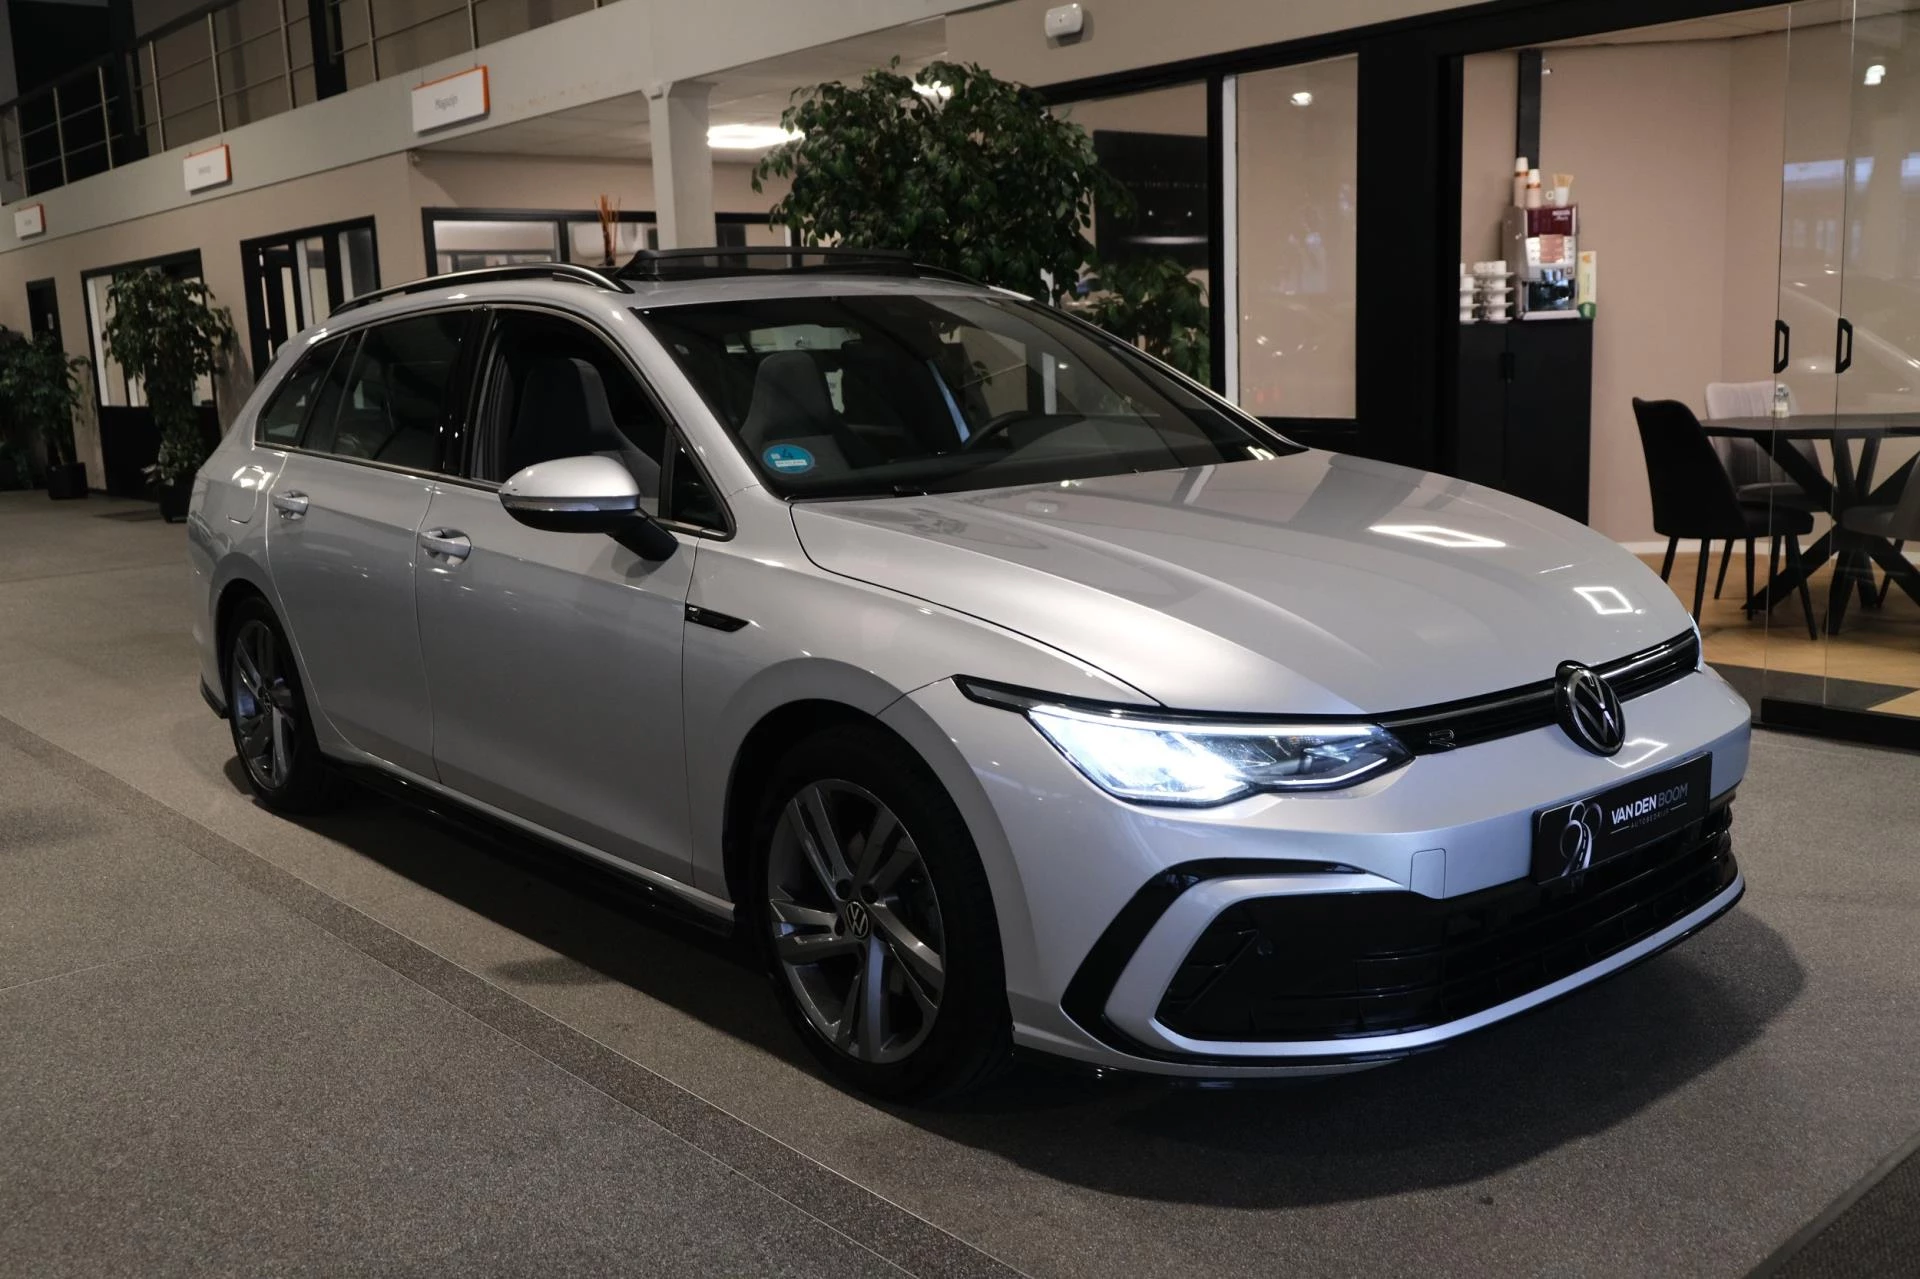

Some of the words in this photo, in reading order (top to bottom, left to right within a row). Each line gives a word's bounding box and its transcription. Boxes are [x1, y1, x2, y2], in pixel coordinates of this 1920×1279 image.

[1611, 803, 1634, 825] VAN
[1634, 794, 1657, 817] DEN
[1658, 782, 1689, 808] BOOM
